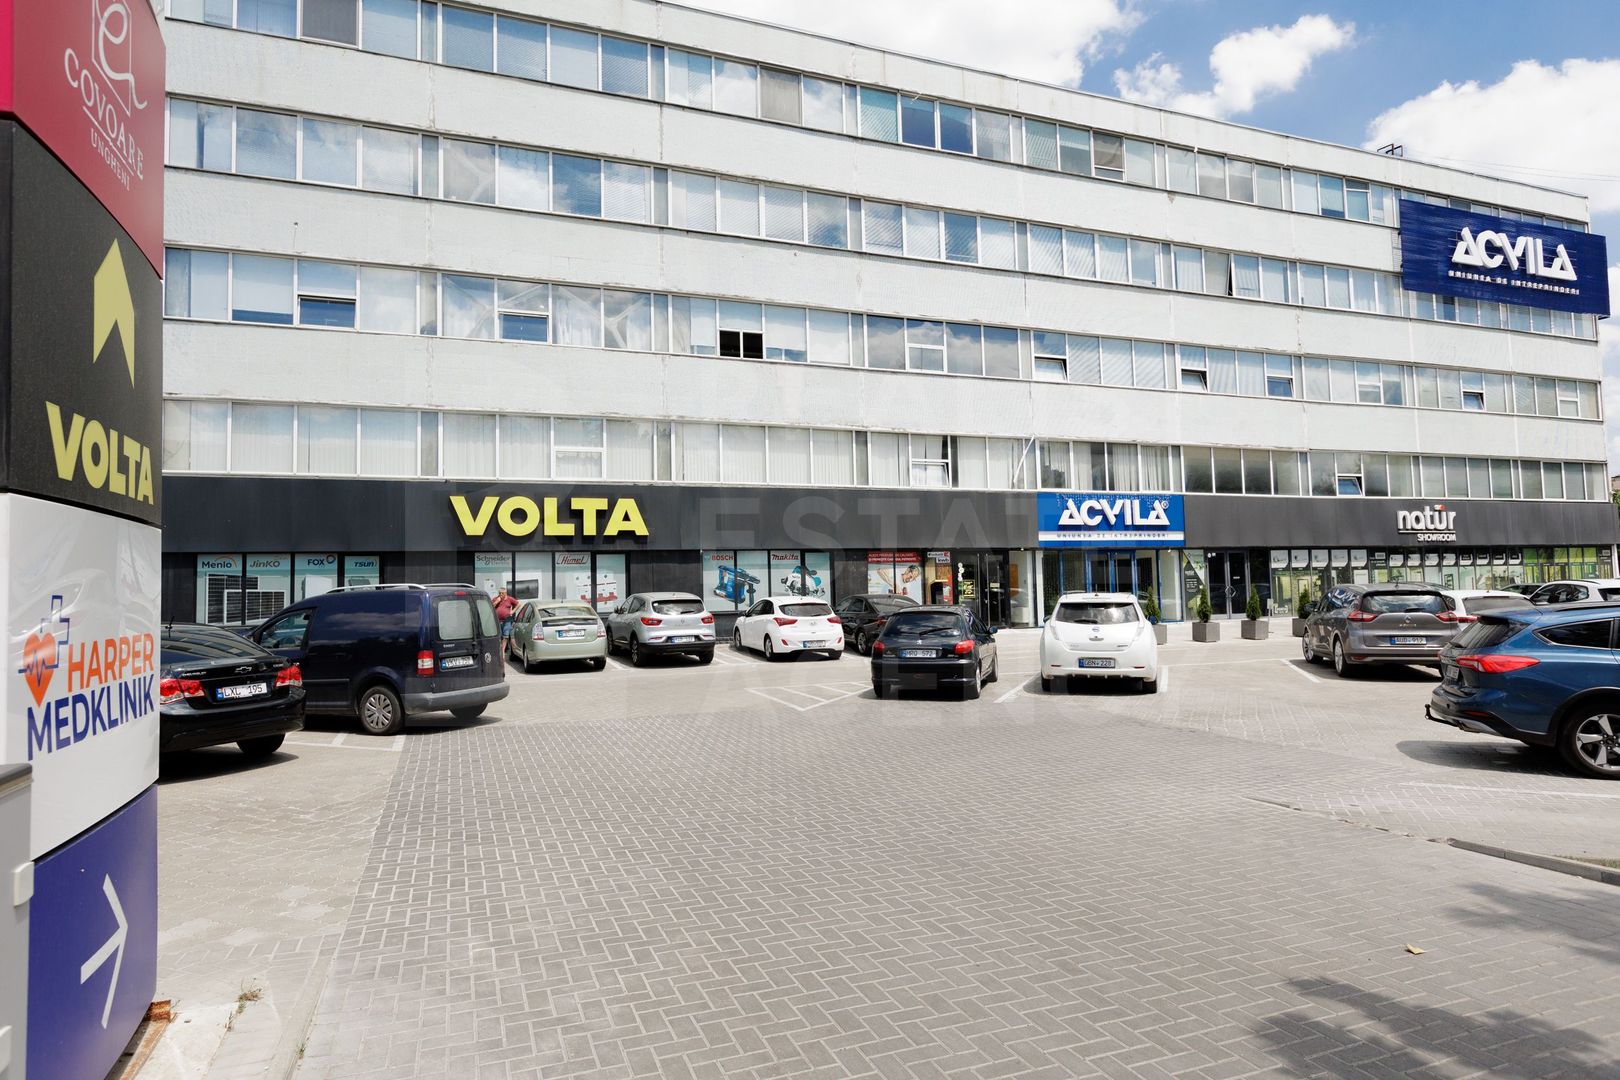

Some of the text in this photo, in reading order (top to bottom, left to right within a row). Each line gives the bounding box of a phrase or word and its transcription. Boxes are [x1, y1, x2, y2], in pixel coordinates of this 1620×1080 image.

[64, 48, 143, 180] COVOARE
[91, 128, 130, 191] UNGHENI
[1451, 226, 1578, 281] ACVILA
[46, 401, 154, 505] VOLTA
[449, 495, 649, 537] VOLTA
[1058, 498, 1171, 526] ACVILA
[1417, 533, 1457, 542] SHOWROOM
[201, 560, 232, 569] Menlo
[307, 558, 325, 567] FOX
[68, 633, 155, 693] HARPER
[27, 673, 155, 761] MEDKLINIK
